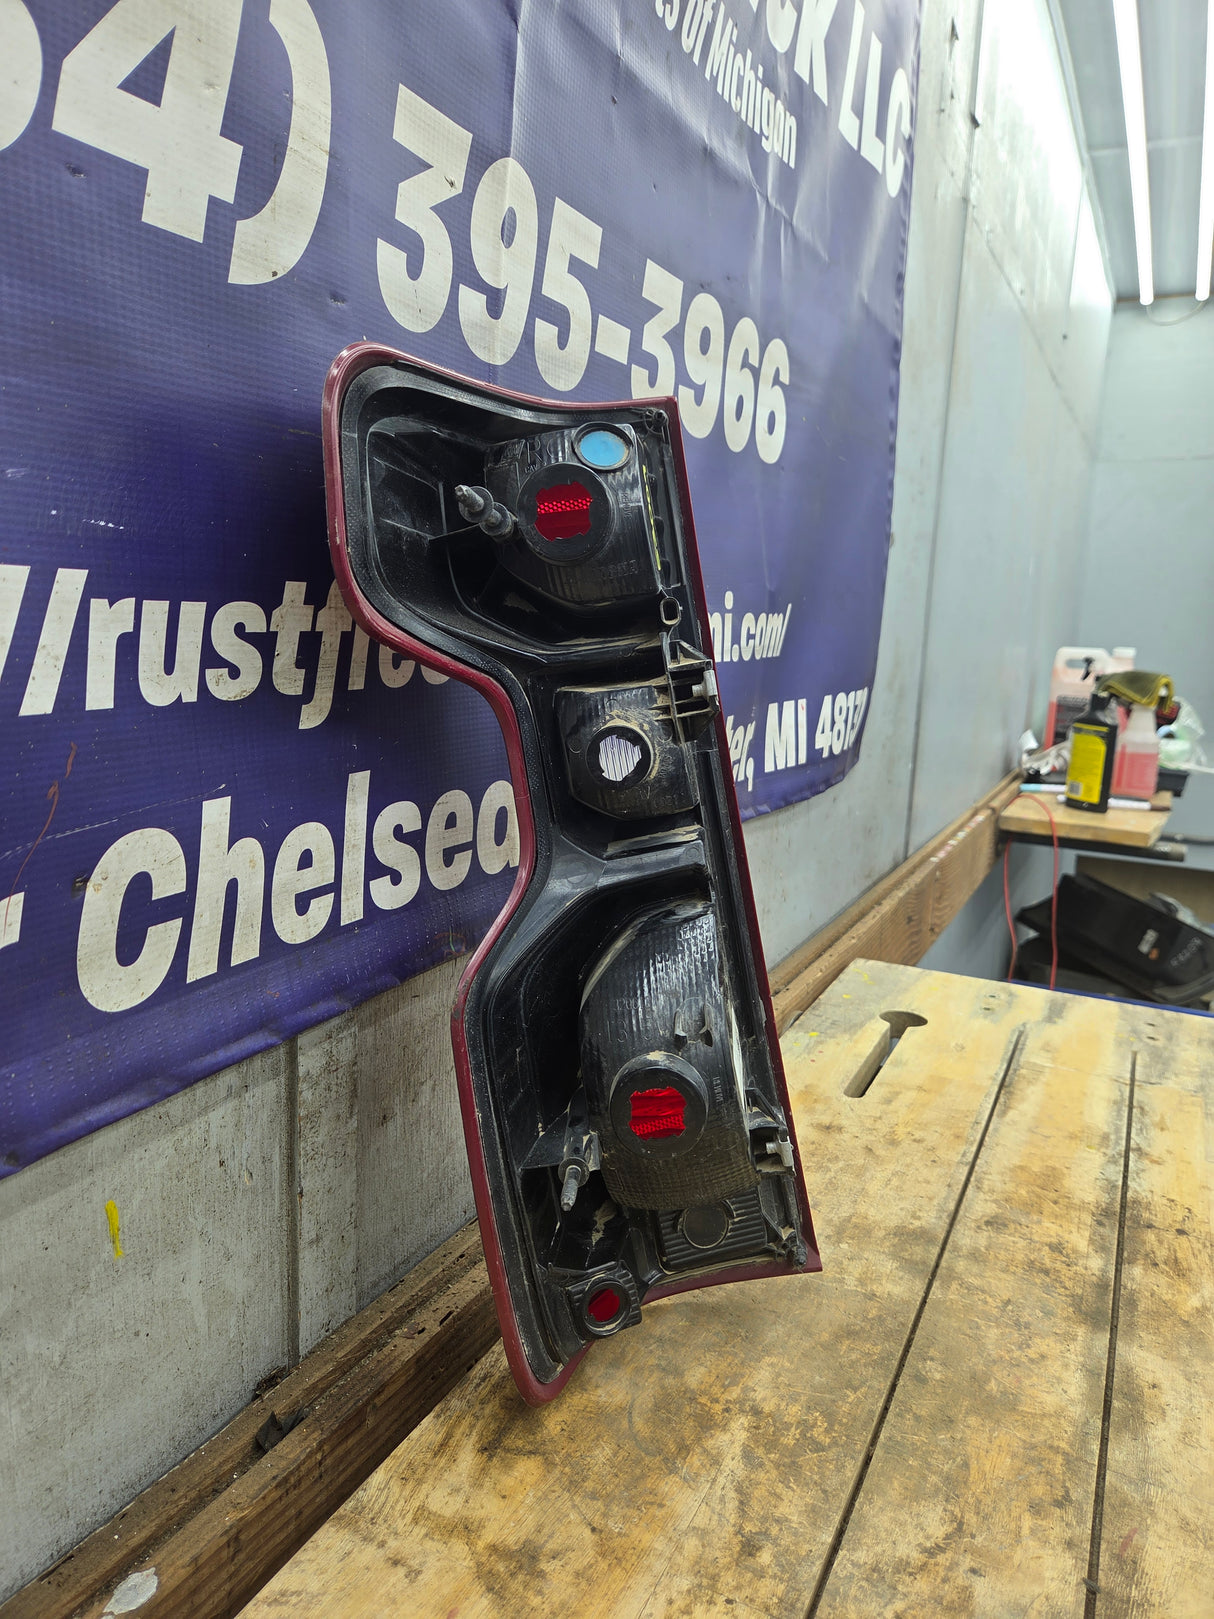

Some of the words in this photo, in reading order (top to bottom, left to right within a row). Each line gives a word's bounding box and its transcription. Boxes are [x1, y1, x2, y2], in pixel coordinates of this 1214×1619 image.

[704, 1, 797, 169] Michigan
[838, 0, 911, 198] LLC
[376, 83, 790, 464] 395-3966
[76, 770, 521, 1013] Chelsea
[764, 698, 807, 773] MI
